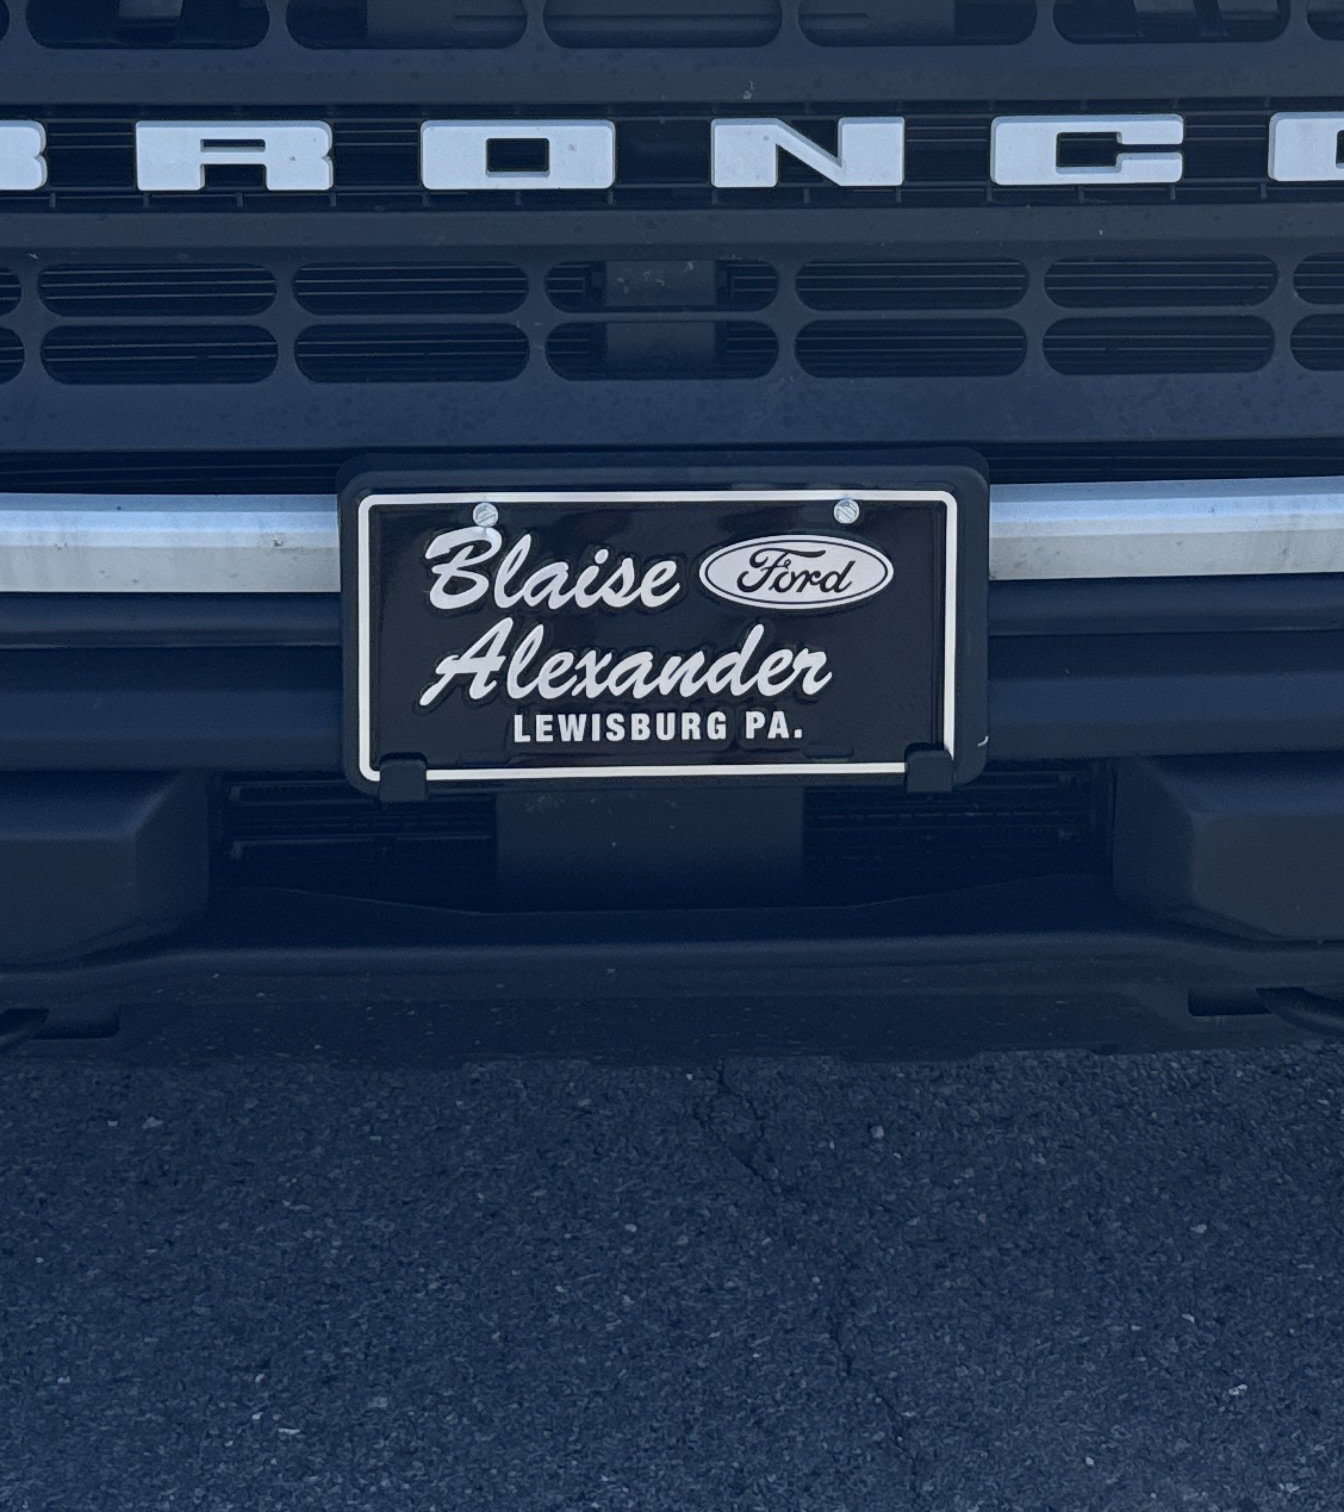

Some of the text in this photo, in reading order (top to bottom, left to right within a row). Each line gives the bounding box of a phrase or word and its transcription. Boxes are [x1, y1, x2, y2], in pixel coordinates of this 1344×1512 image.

[423, 525, 681, 610] Blaise
[736, 549, 853, 595] Ford
[419, 616, 833, 706] Alexander
[513, 710, 804, 743] LEWISBURG PA.
